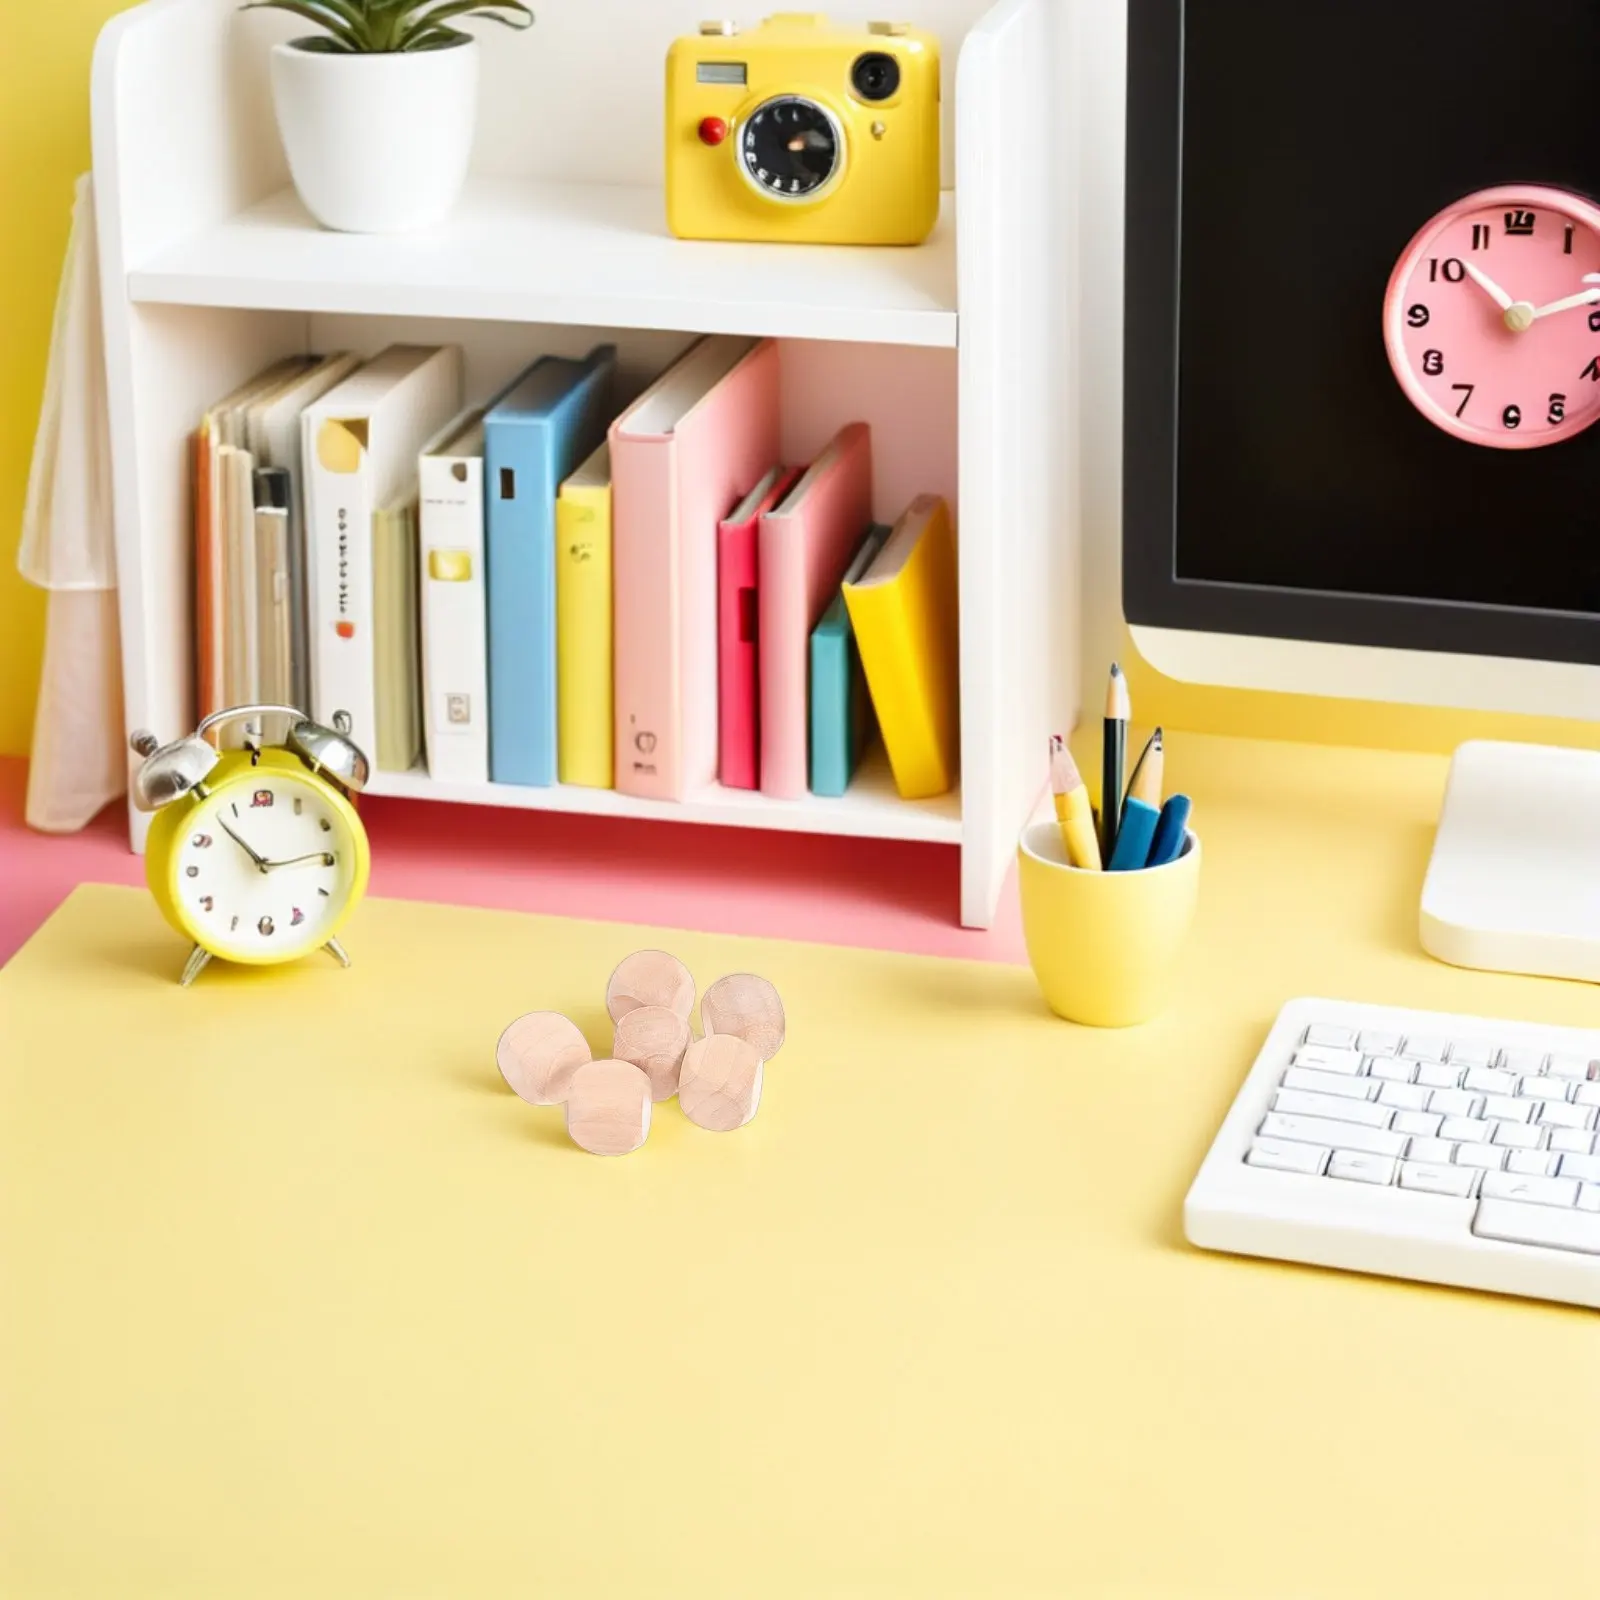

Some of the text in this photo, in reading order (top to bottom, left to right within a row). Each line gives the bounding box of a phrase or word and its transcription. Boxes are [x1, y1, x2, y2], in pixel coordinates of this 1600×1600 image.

[1429, 258, 1466, 282] 10
[1407, 304, 1430, 328] 9
[1451, 384, 1475, 418] 7
